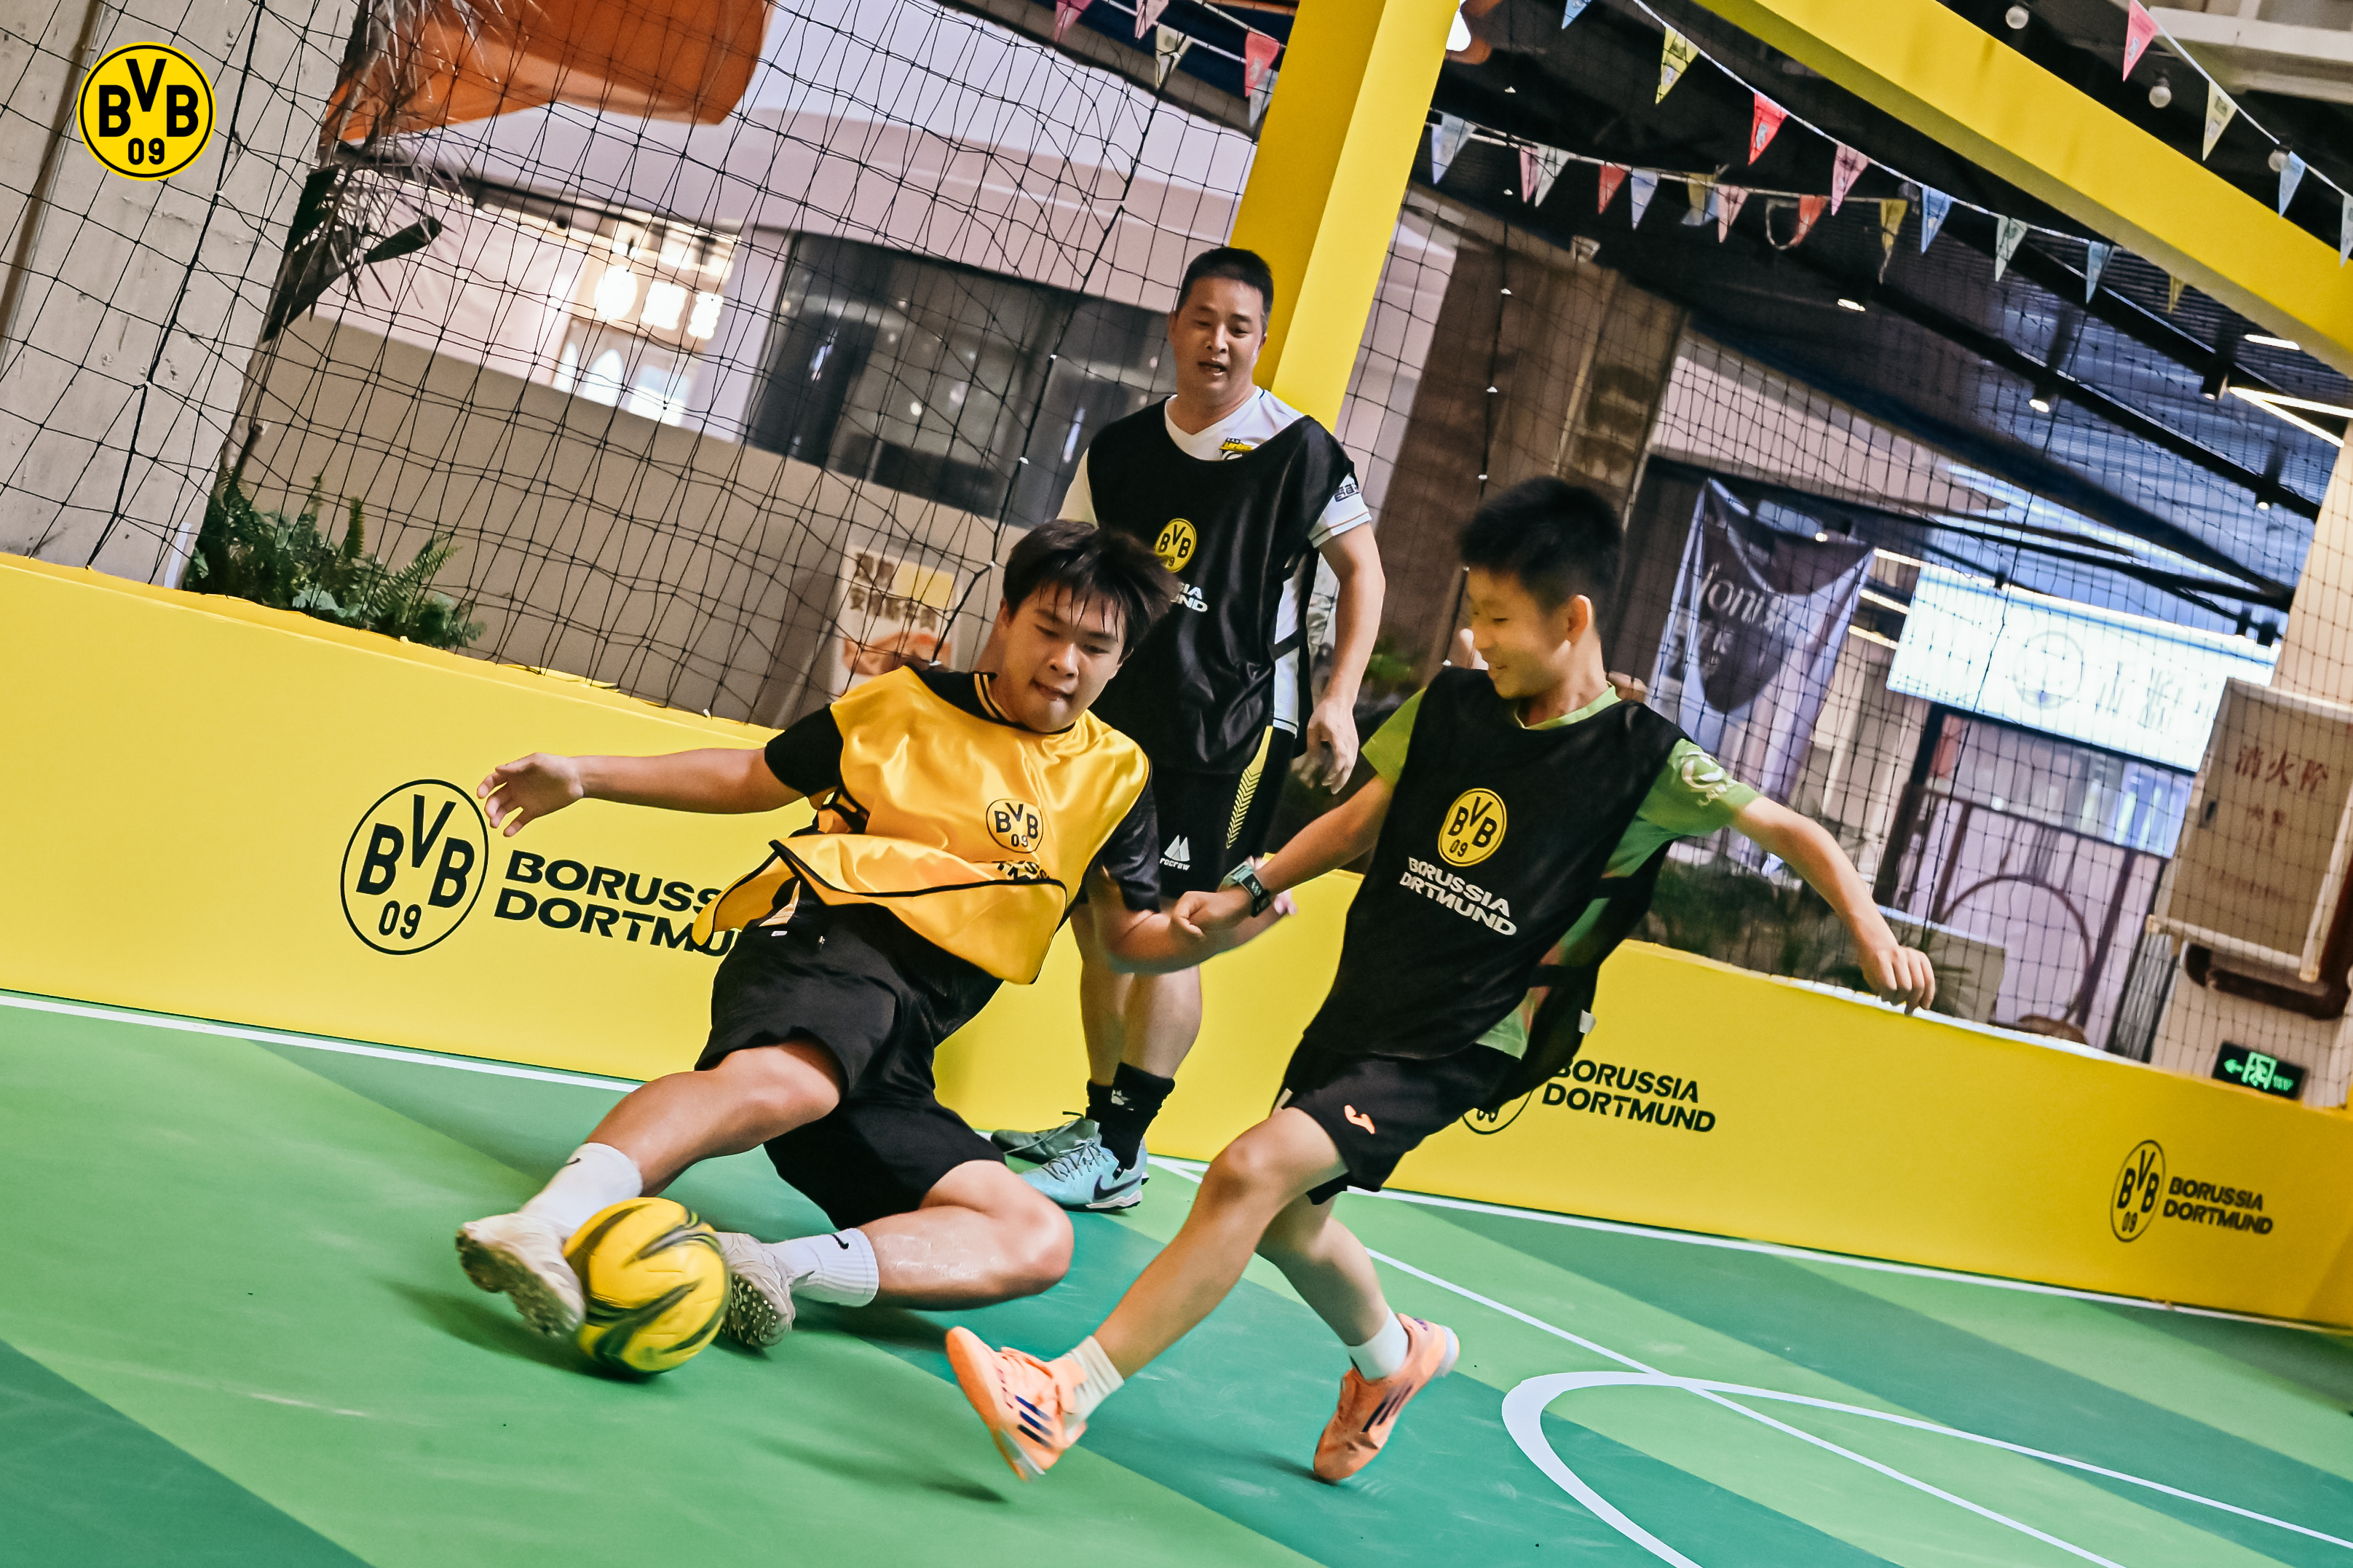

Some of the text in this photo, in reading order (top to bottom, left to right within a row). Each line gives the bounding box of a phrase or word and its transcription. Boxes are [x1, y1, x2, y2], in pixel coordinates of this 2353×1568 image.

[1158, 524, 1191, 558] BVB
[994, 802, 1039, 839] BVB
[1448, 796, 1498, 848] BVB
[356, 793, 475, 908] BVB
[1449, 839, 1468, 858] 09
[505, 849, 723, 916] BORUSS
[379, 900, 422, 940] 09
[494, 887, 737, 957] DORTMU
[1542, 1082, 1716, 1133] DORTMUND
[2117, 1149, 2160, 1213] BVB
[2169, 1176, 2263, 1212] BORUSSIA
[2163, 1198, 2274, 1235] DORTMUND
